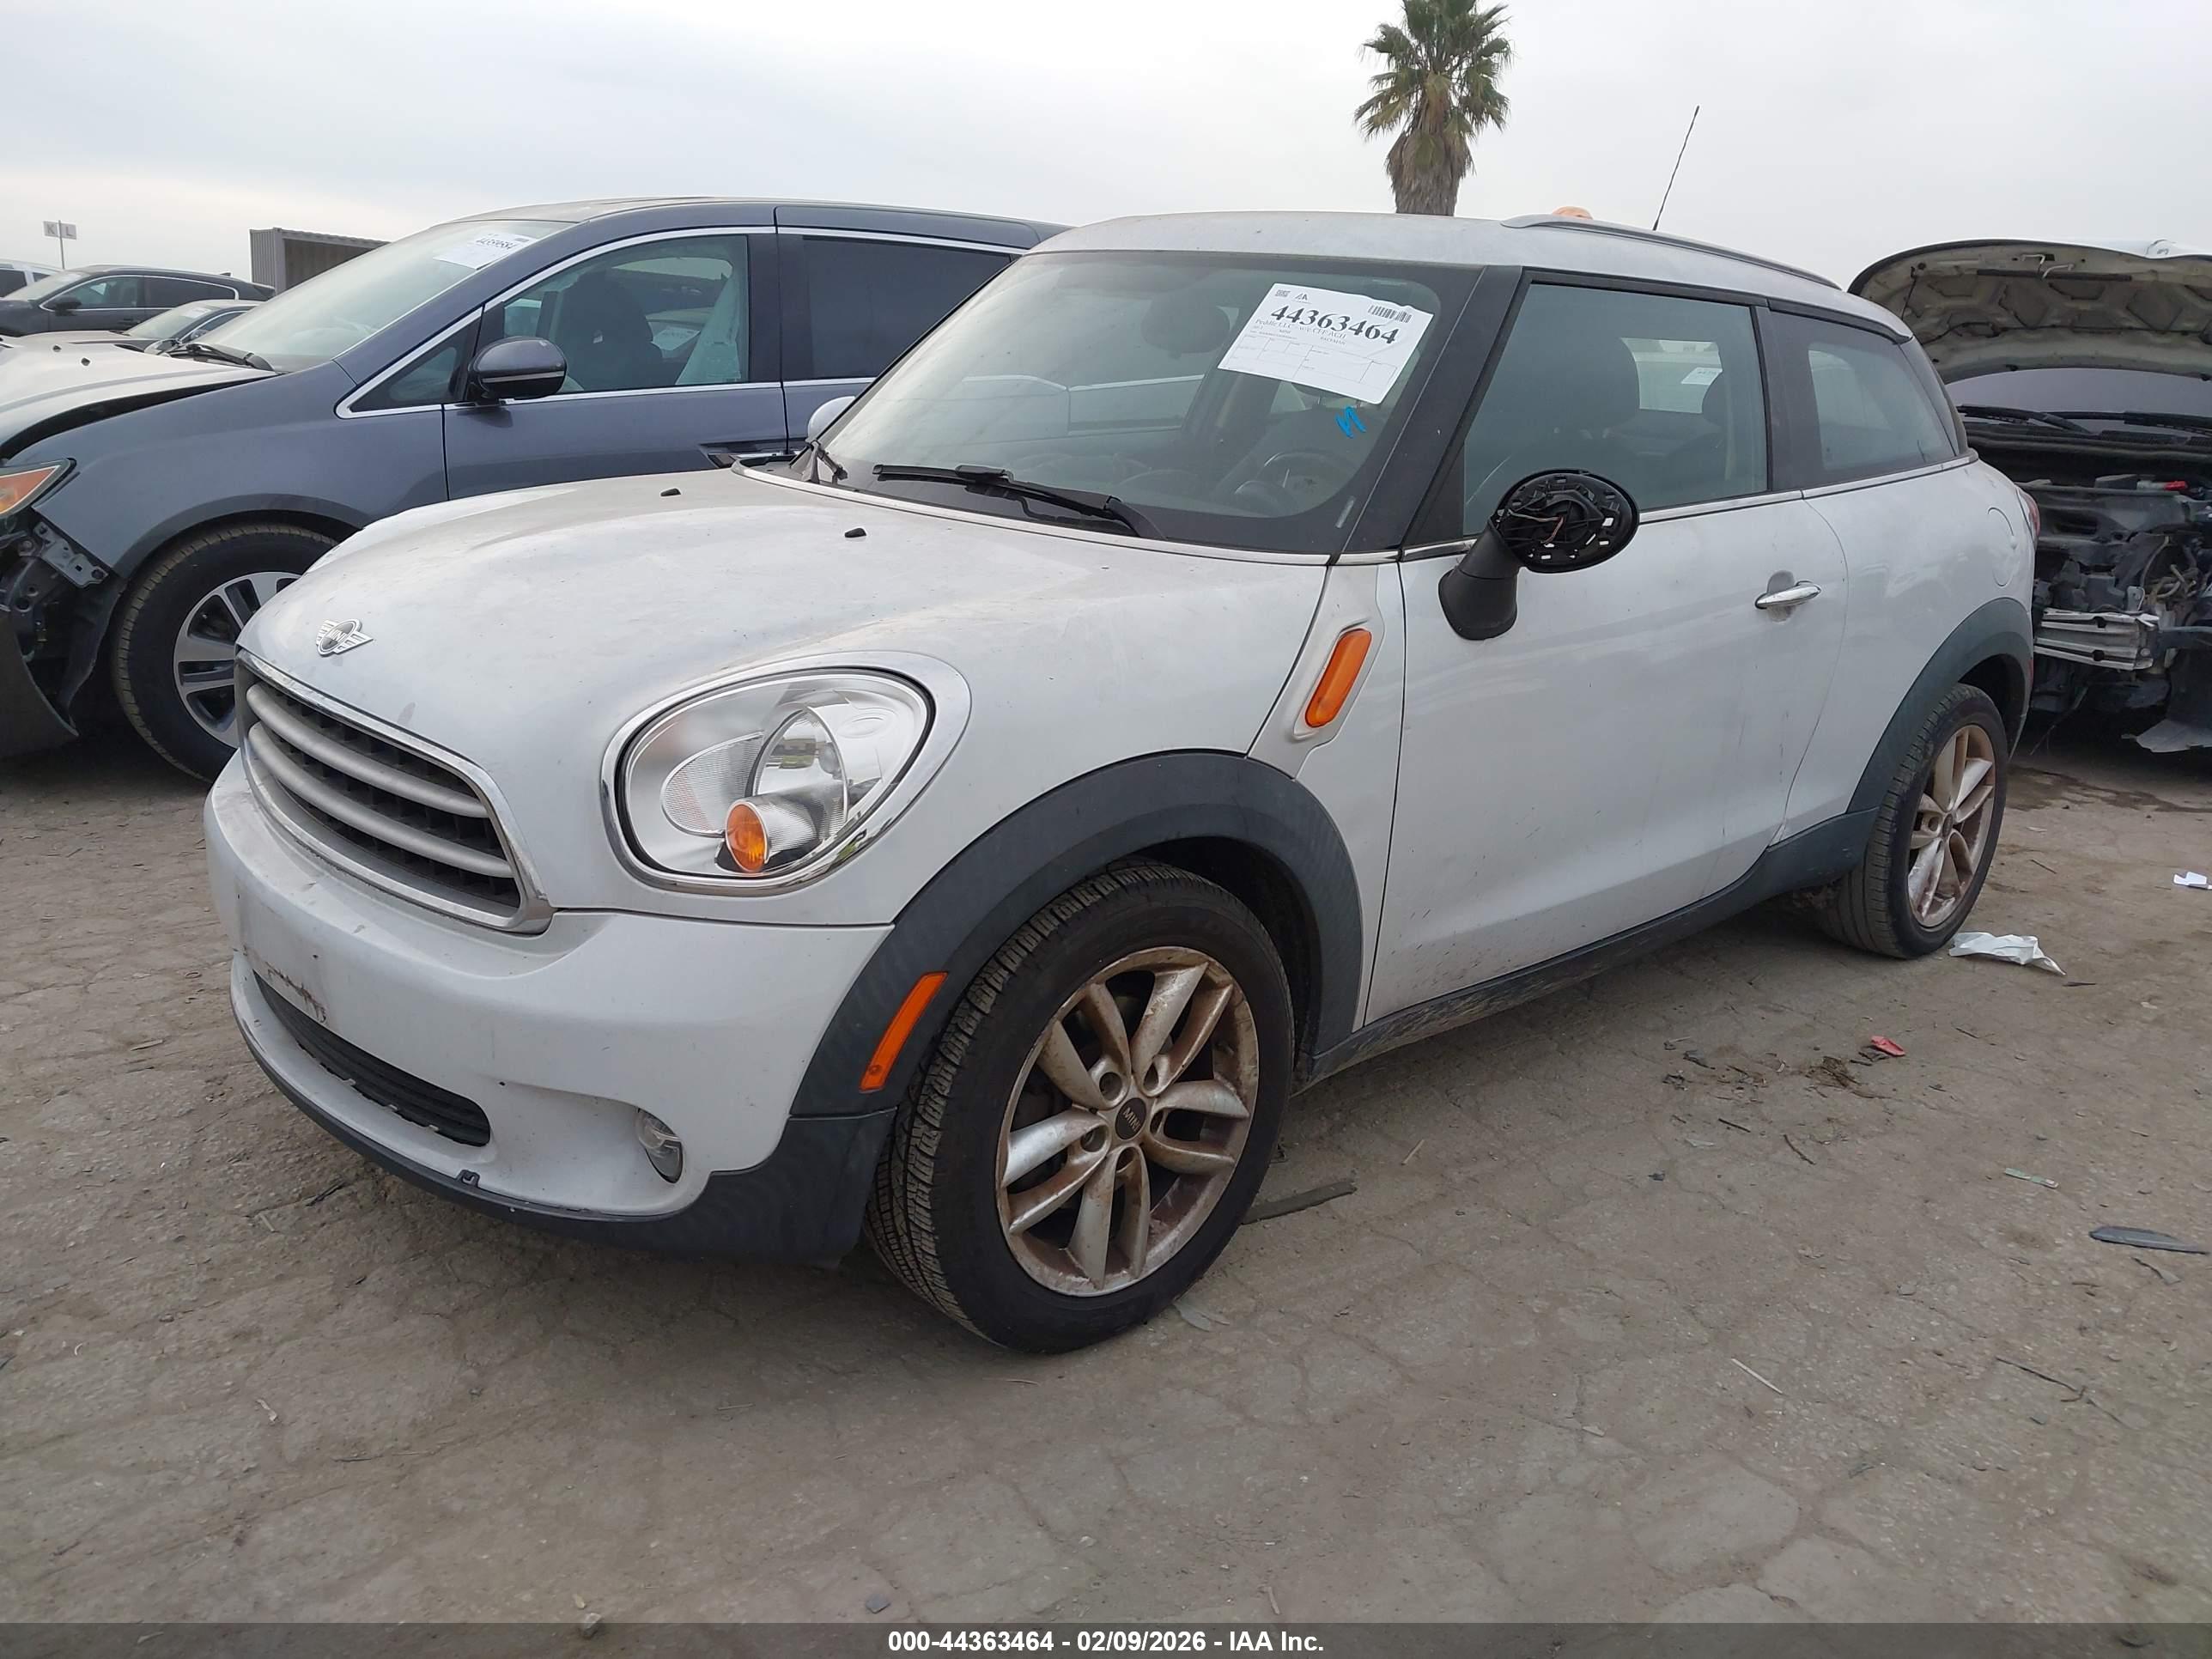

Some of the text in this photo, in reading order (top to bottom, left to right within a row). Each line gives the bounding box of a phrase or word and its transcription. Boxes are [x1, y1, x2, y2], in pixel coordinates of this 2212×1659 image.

[47, 223, 56, 234] K
[65, 226, 75, 237] L
[1271, 305, 1400, 344] 44363464
[1122, 1107, 1141, 1133] MINI
